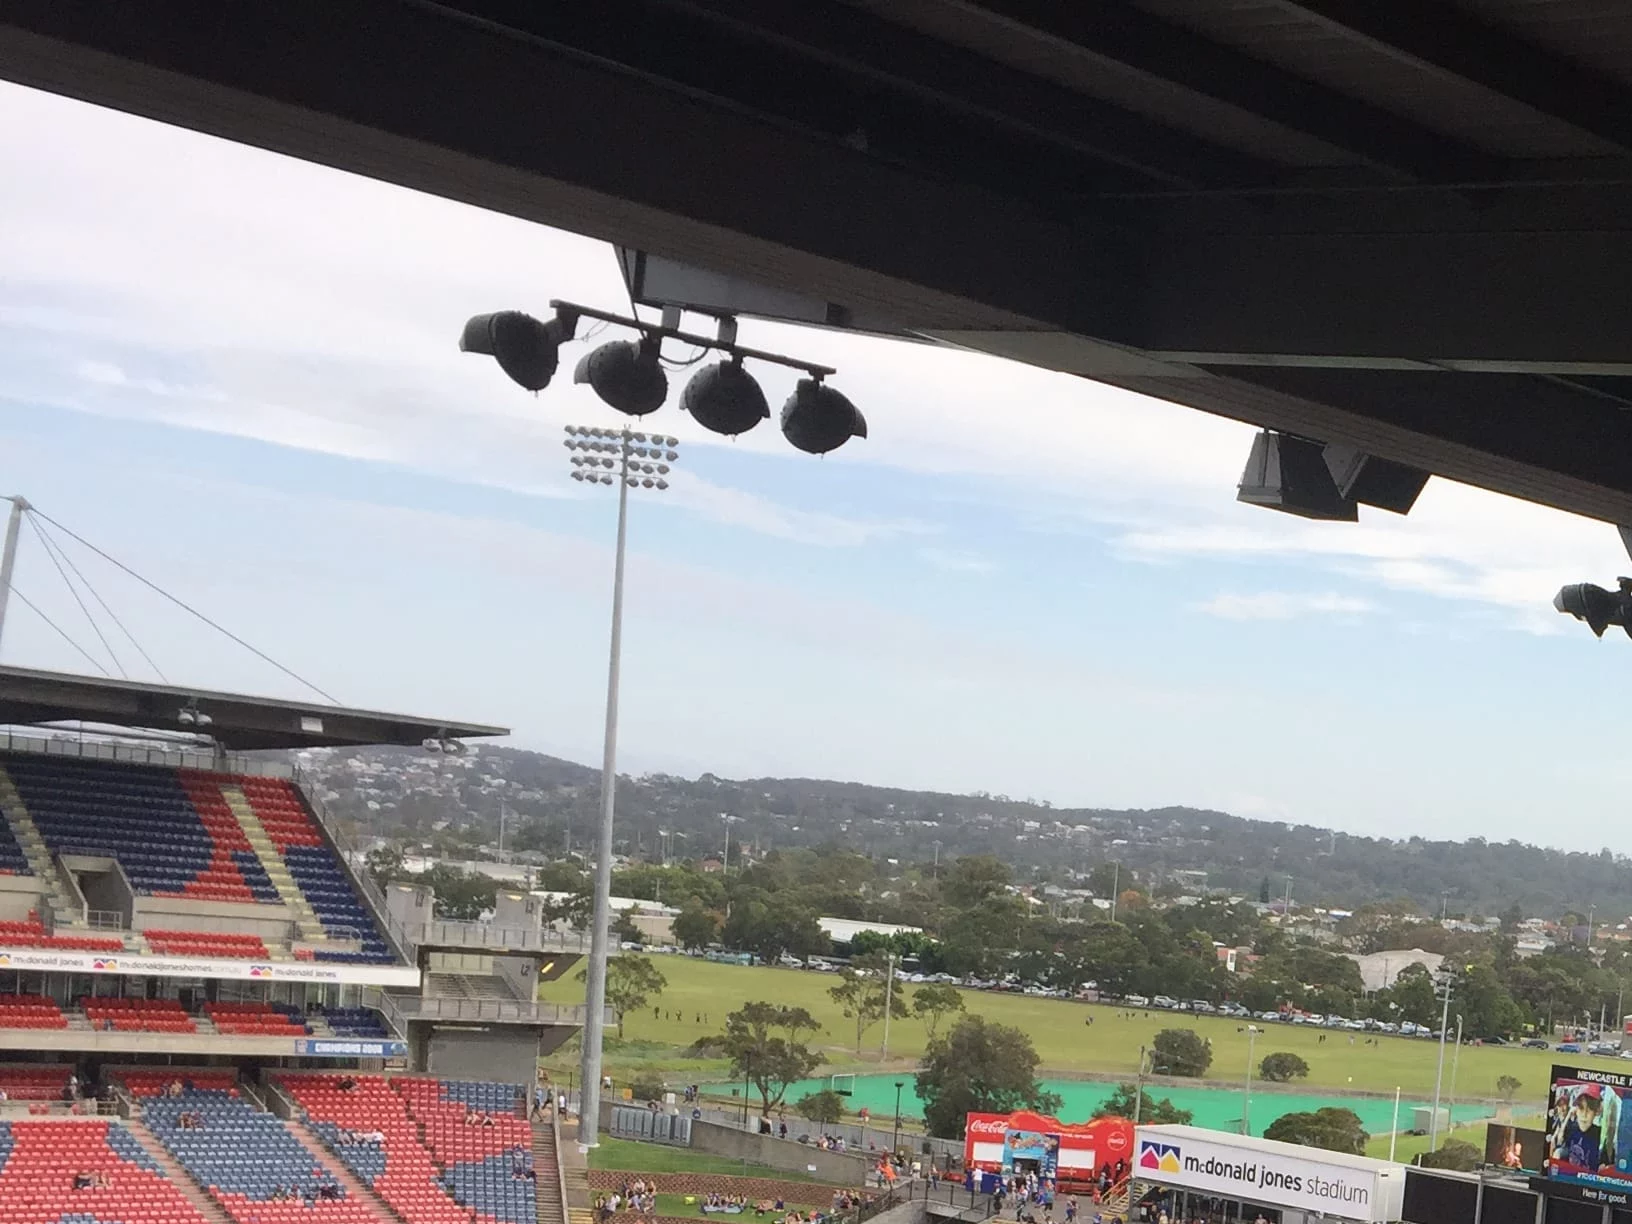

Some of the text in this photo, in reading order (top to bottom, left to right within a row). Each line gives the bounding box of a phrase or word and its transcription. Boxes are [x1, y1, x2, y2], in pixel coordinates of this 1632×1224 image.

[1576, 1070, 1626, 1086] NEWCASTLE
[1184, 1154, 1368, 1204] mcdonald jones stadium
